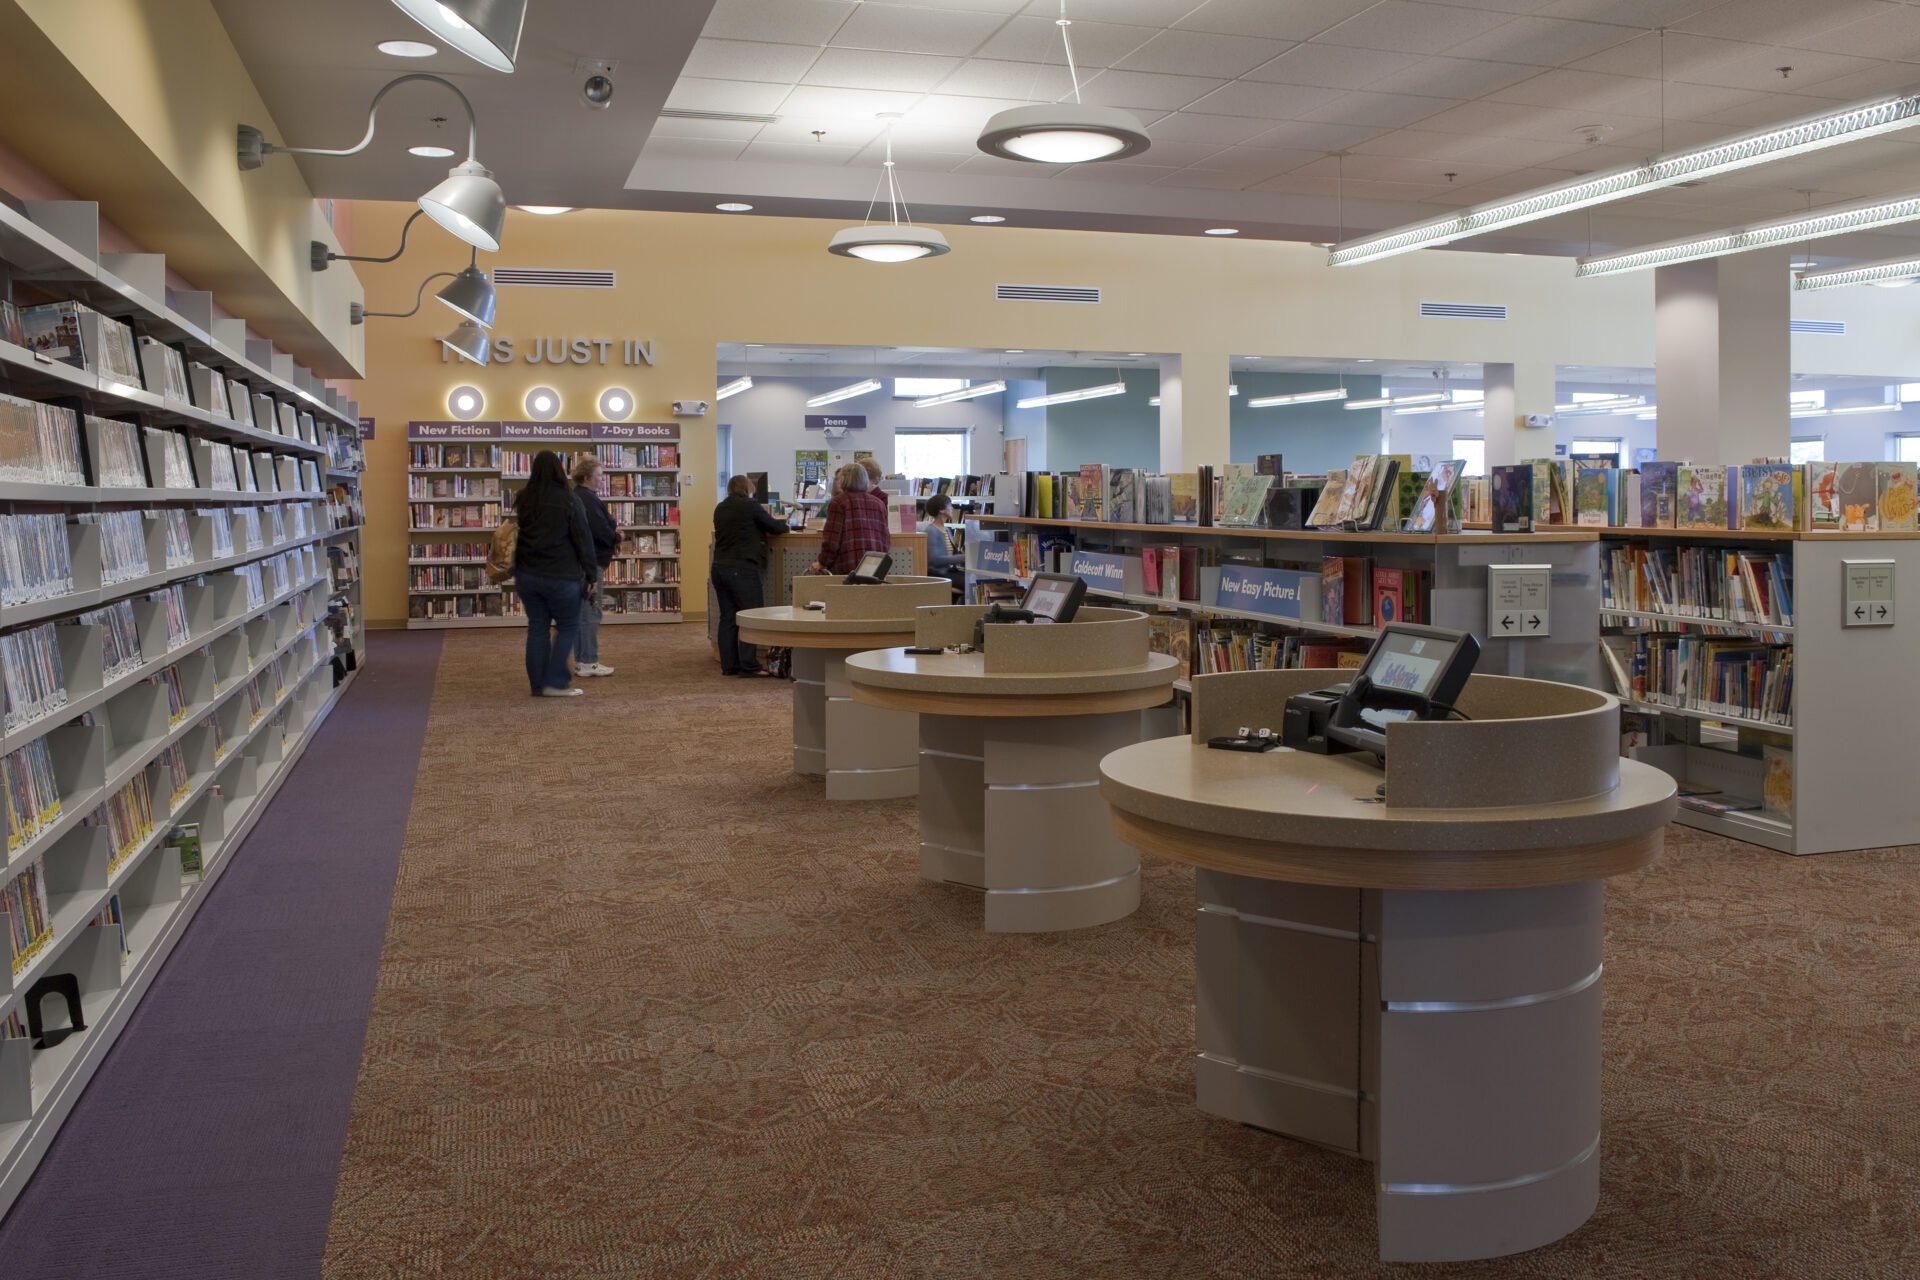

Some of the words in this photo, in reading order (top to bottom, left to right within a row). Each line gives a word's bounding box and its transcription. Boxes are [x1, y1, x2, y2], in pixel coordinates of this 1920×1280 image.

[435, 336, 514, 364] TS
[525, 337, 613, 366] JUST
[623, 338, 655, 366] IN
[823, 417, 848, 426] Teens
[419, 425, 448, 436] New
[451, 425, 491, 436] Fiction
[505, 425, 531, 436] New
[533, 425, 589, 436] Nonfiction
[601, 425, 634, 437] 7-Day
[637, 425, 671, 436] Books
[984, 548, 1004, 564] Concept
[1073, 559, 1104, 577] Caldecott
[1221, 576, 1240, 593] New
[1241, 578, 1262, 600] Easy
[1263, 581, 1294, 600] Picture
